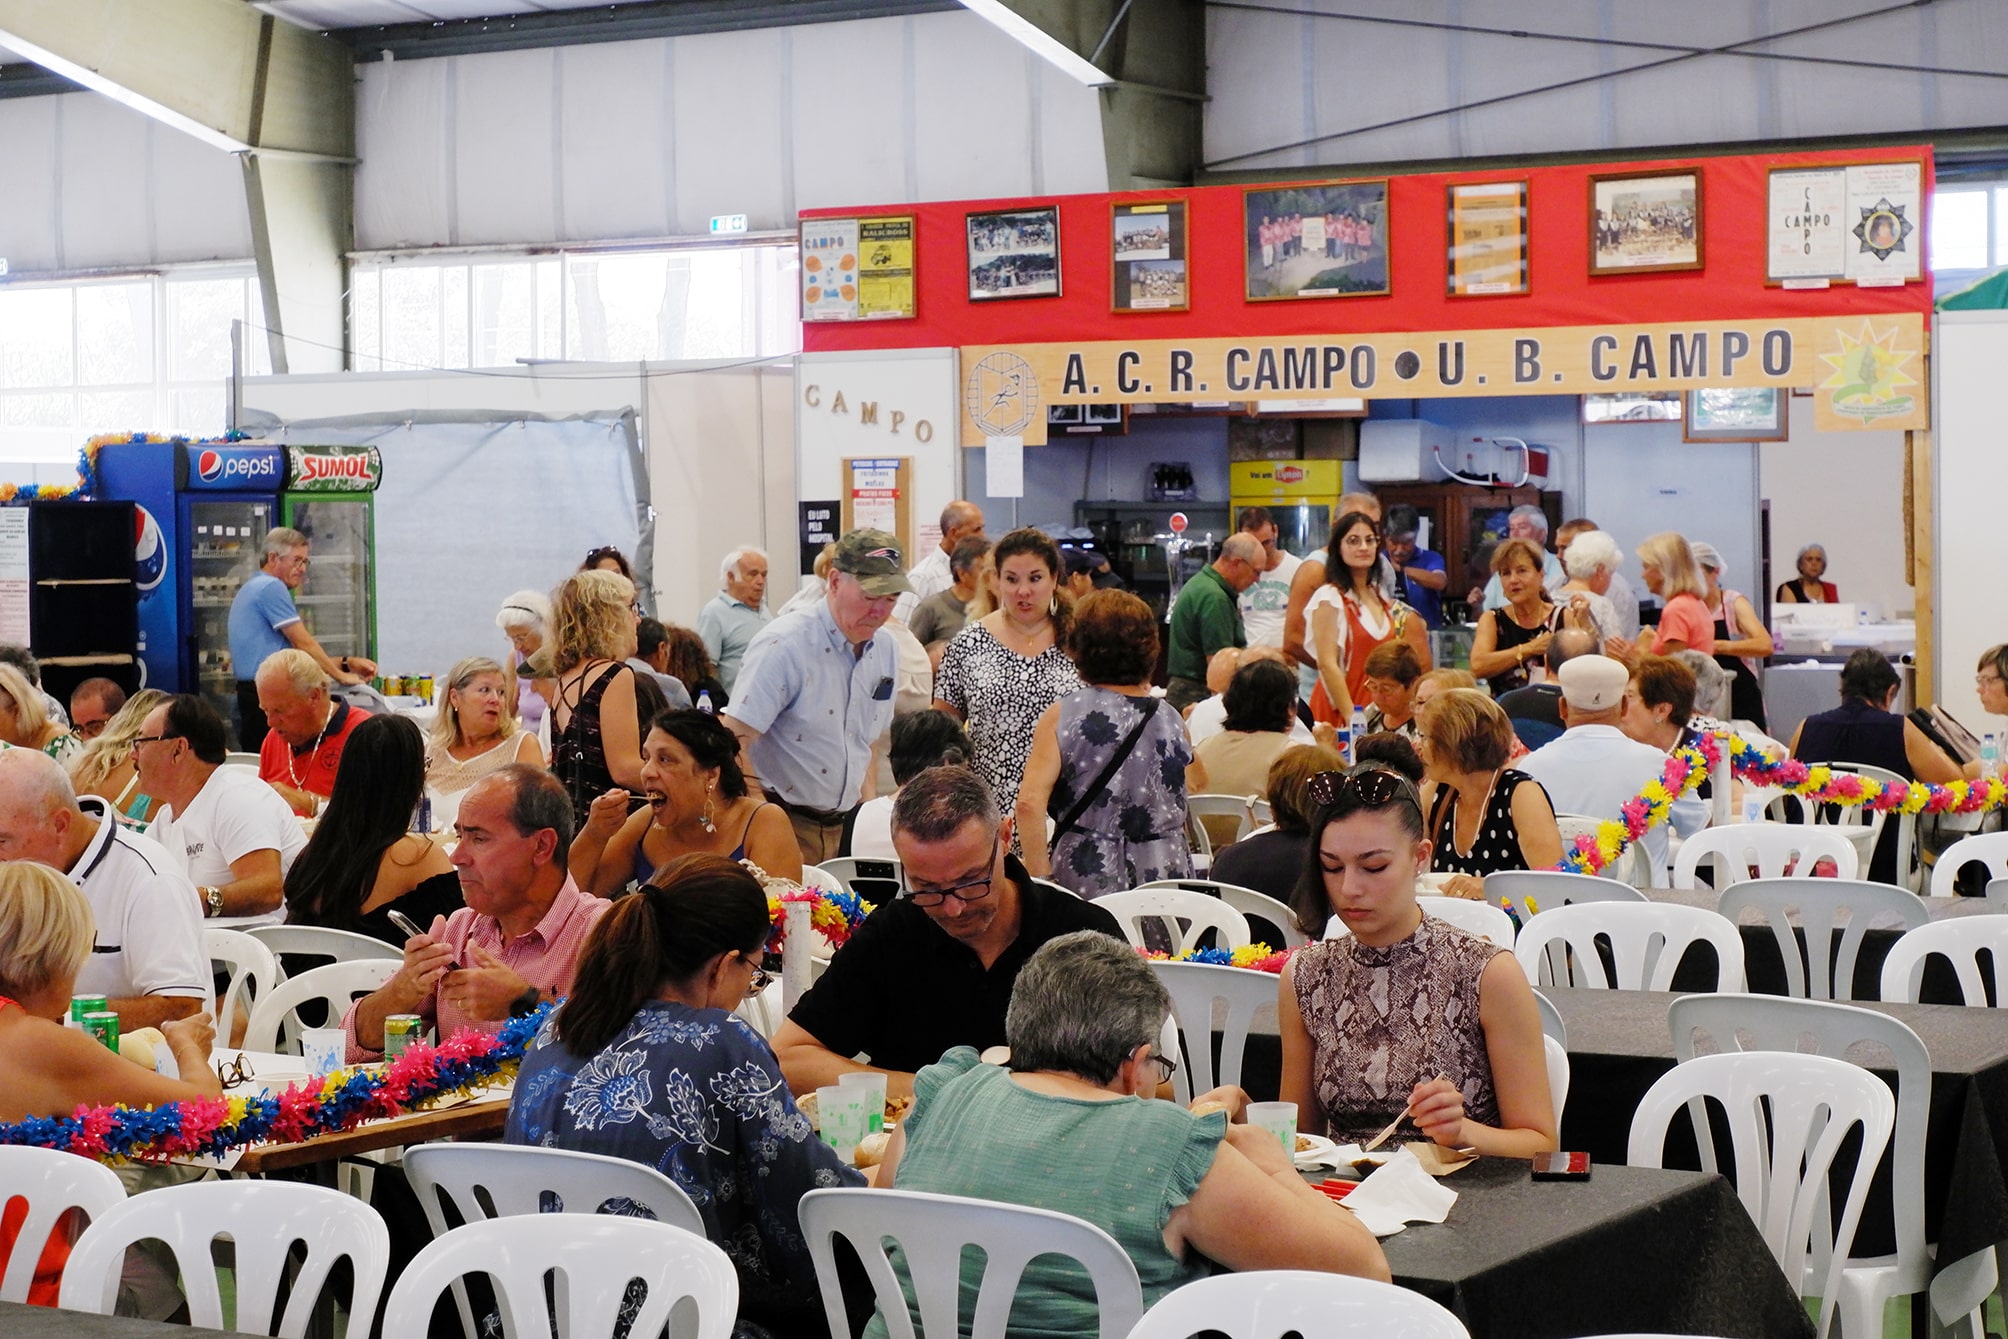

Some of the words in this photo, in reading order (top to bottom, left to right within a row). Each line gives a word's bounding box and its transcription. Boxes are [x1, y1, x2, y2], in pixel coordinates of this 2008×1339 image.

[1785, 214, 1830, 228] CAMPO
[805, 236, 844, 250] CAMPO
[1062, 352, 1100, 394] A.
[1117, 351, 1152, 393] C.
[1170, 350, 1208, 392] R.
[1226, 345, 1376, 391] CAMPO
[1438, 340, 1487, 385] U.
[1514, 337, 1563, 383] B.
[1591, 329, 1792, 381] CAMPO
[224, 455, 275, 479] pepsi
[299, 456, 372, 482] SUMOL
[1277, 470, 1303, 480] Lipton
[808, 521, 823, 531] PELO
